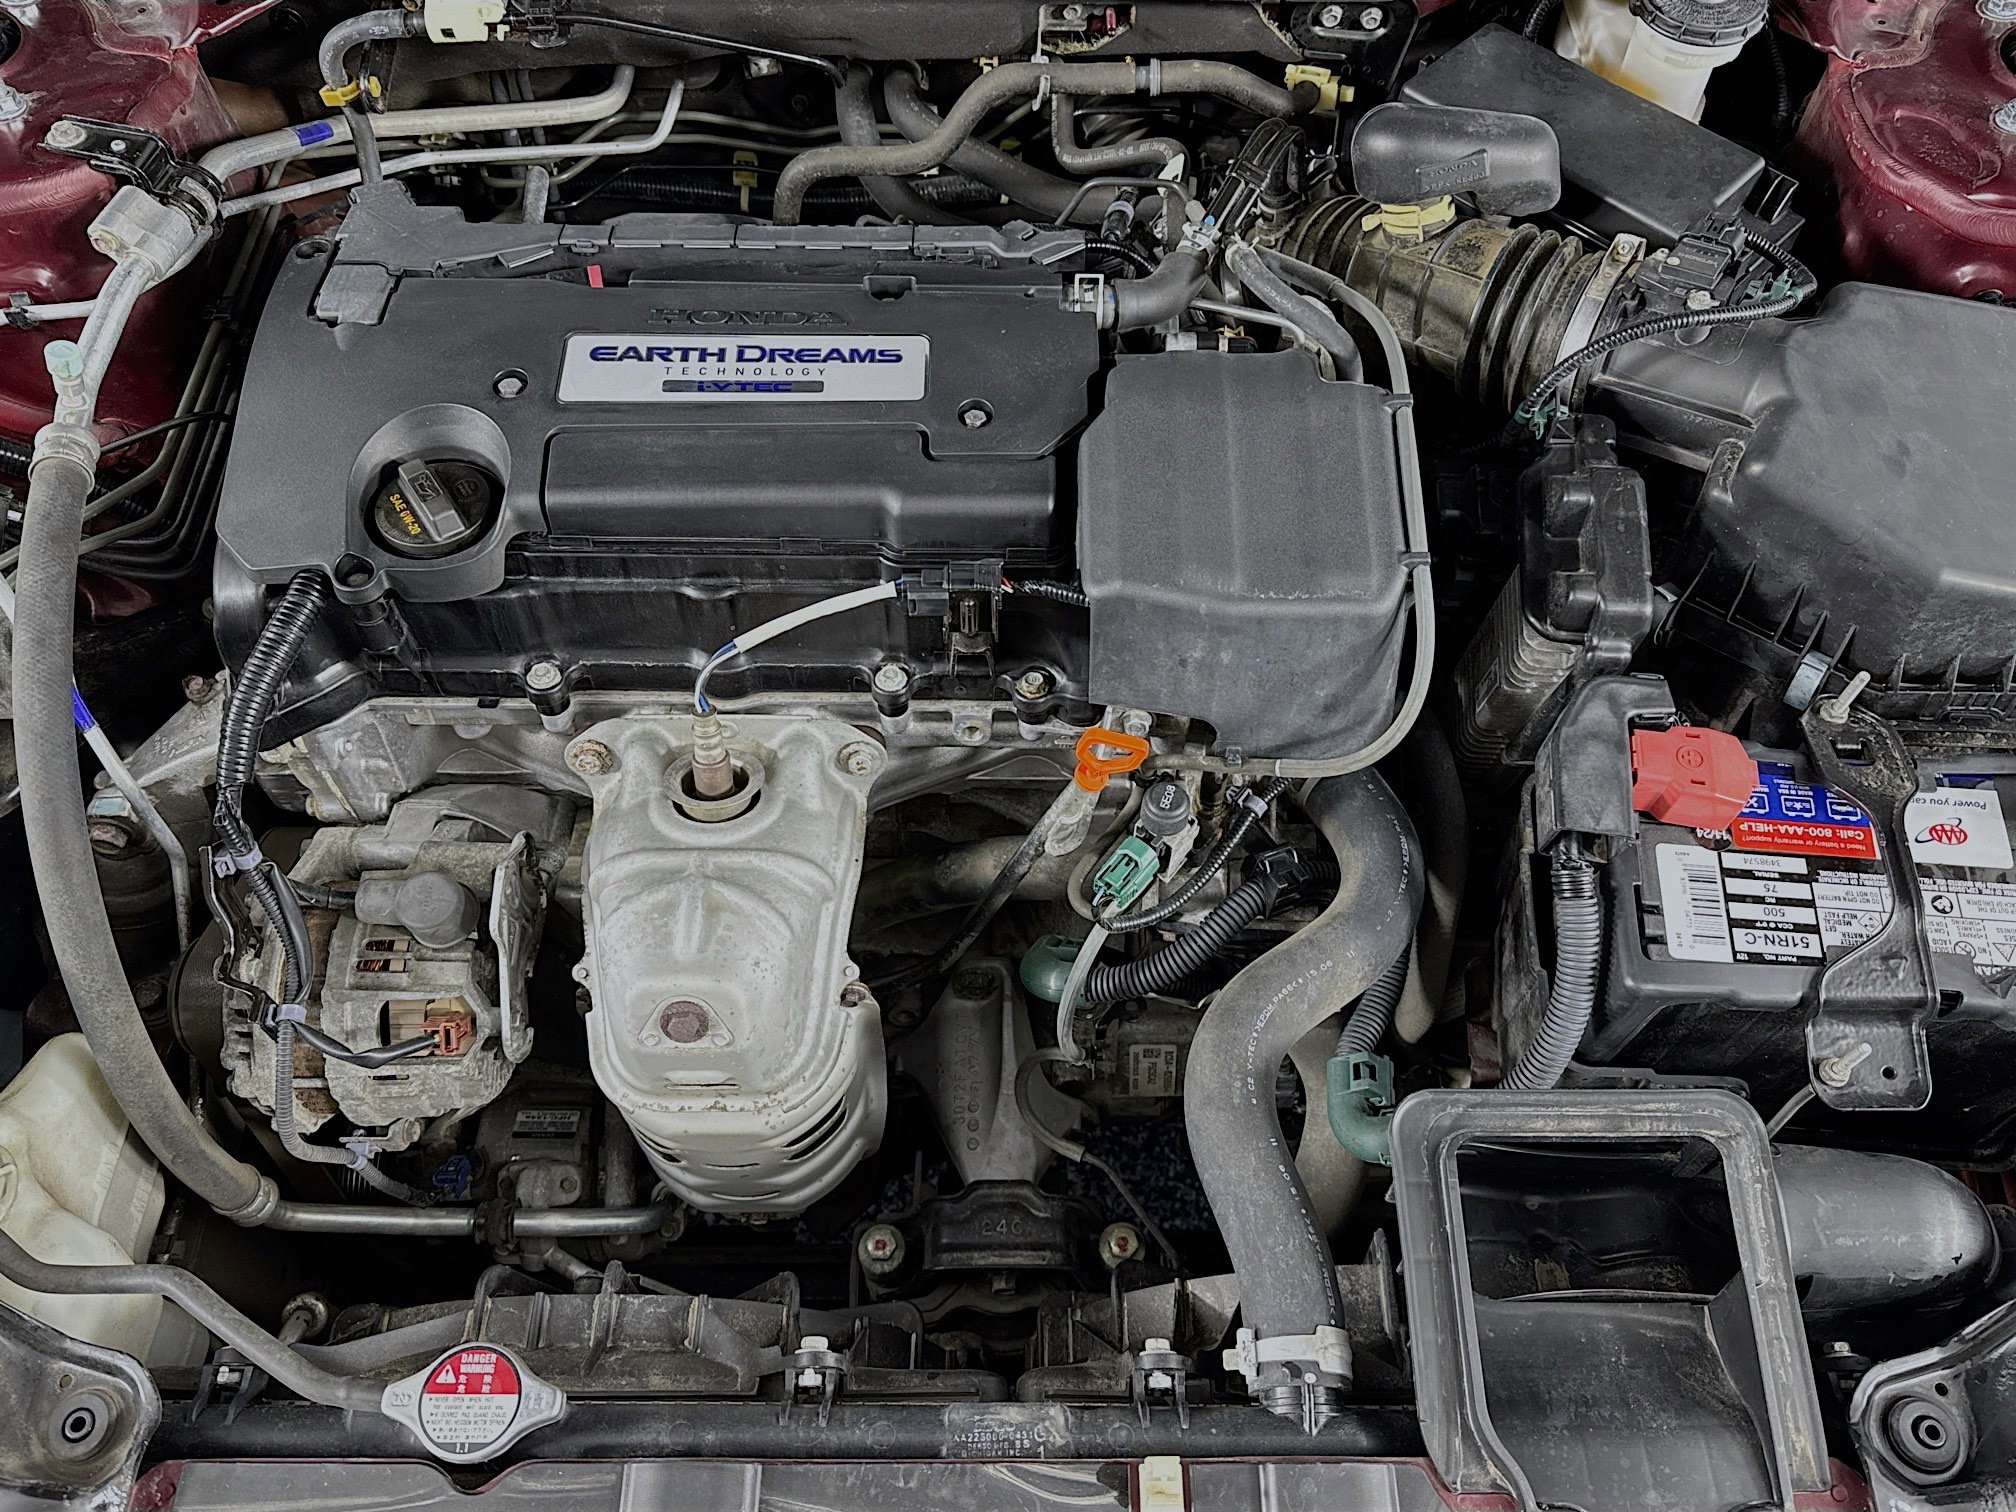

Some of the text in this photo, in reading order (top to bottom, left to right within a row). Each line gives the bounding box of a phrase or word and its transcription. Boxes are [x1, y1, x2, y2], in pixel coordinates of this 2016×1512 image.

[647, 309, 849, 326] HONDA
[589, 344, 904, 364] EARTH DREAMS
[664, 366, 828, 377] TECHNOLOGY
[696, 380, 794, 393] i-VTEC
[389, 493, 422, 536] SAE 0W-20
[1160, 781, 1177, 810] 5E08
[1930, 798, 1950, 806] you
[1953, 800, 1987, 810] Power
[1739, 822, 1865, 840] Call: 800-AAA-HELP
[1934, 828, 1964, 844] AAA
[1742, 834, 1773, 844] support?
[1774, 836, 1804, 846] warranty
[1815, 839, 1839, 849] battery
[1847, 843, 1866, 851] Need
[1743, 857, 1782, 868] 3498574
[1752, 870, 1780, 879] SERIAL
[1763, 884, 1778, 893] 75
[1763, 907, 1786, 917] 500
[1776, 922, 1794, 930] CCA
[1822, 918, 1852, 926] MEDICAL
[1744, 932, 1810, 949] 51RN-C
[1932, 938, 1948, 946] ACID
[1978, 946, 1987, 954] NO
[1736, 952, 1798, 962] PART NO. 12V
[1248, 1077, 1255, 1091] C2
[1320, 960, 1334, 971] 06
[461, 1353, 498, 1364] DANGER
[460, 1363, 496, 1374] WARNUNG
[456, 1443, 469, 1453] 1.1
